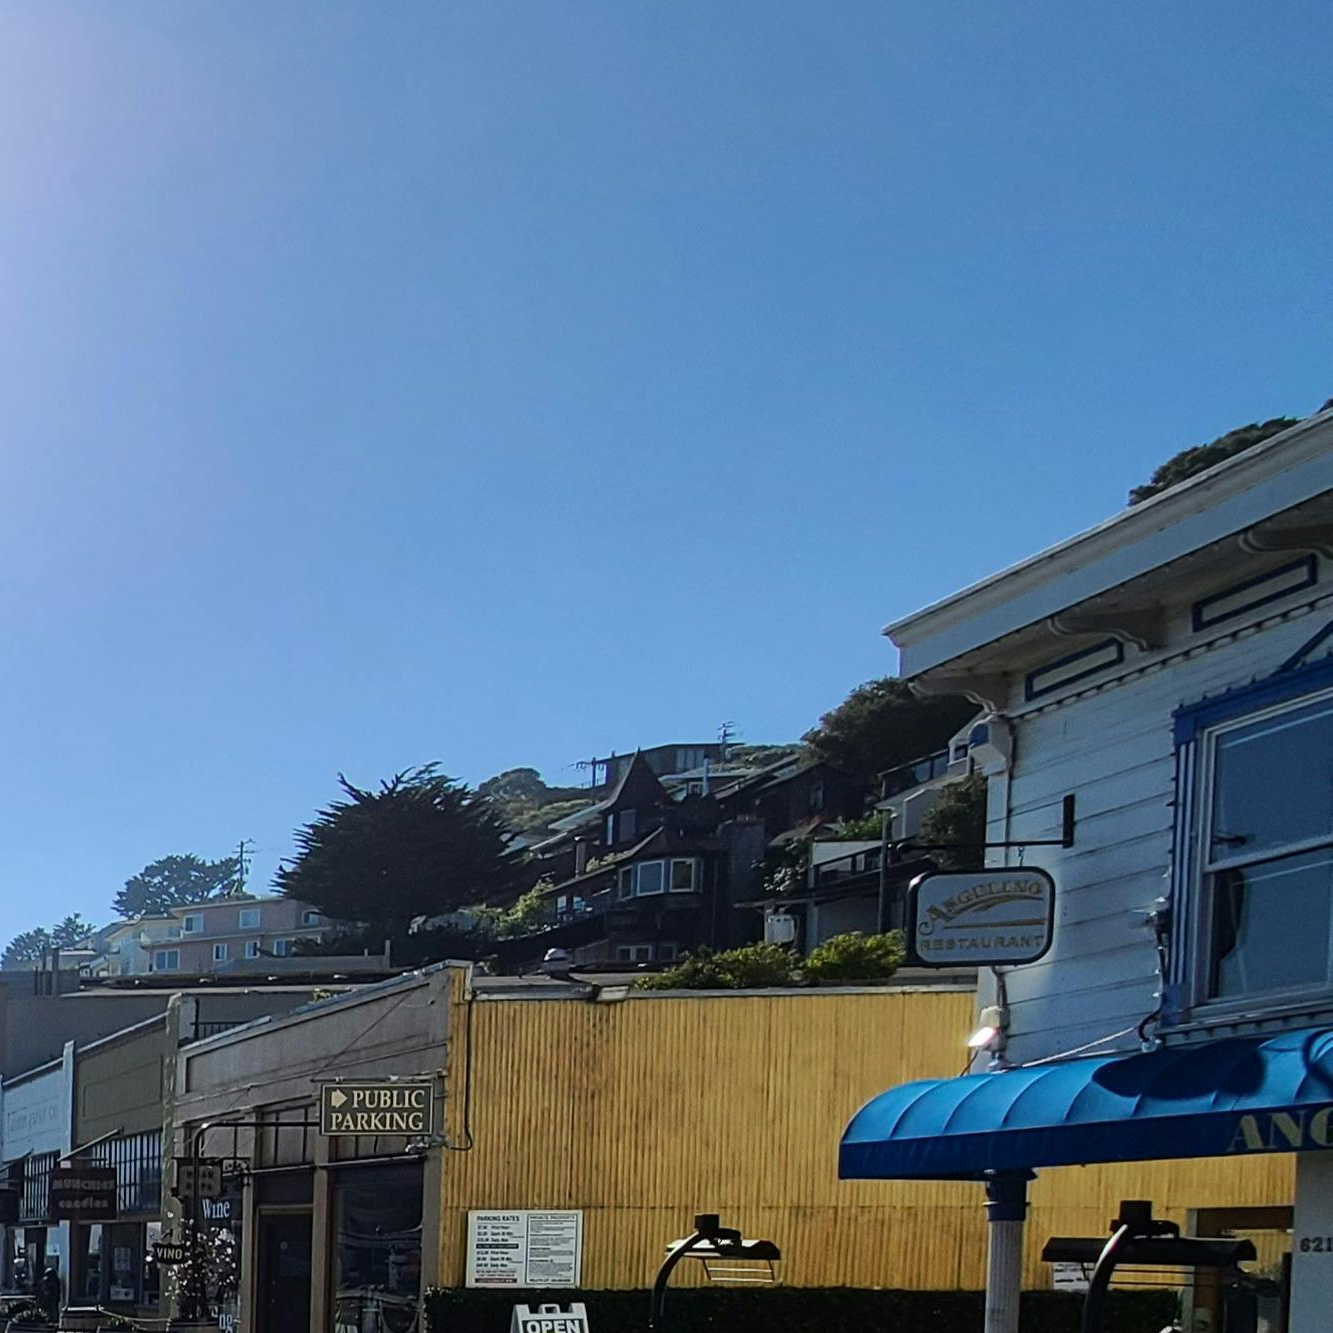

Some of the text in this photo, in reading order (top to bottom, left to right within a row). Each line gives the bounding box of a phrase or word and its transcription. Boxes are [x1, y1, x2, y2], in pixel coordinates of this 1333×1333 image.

[918, 880, 1044, 936] ANGELINO
[920, 935, 1045, 952] RESTAURANT
[352, 1090, 425, 1109] PUBLIC
[330, 1112, 424, 1131] PARKING
[202, 1199, 230, 1219] Wine
[156, 1247, 183, 1260] VINO
